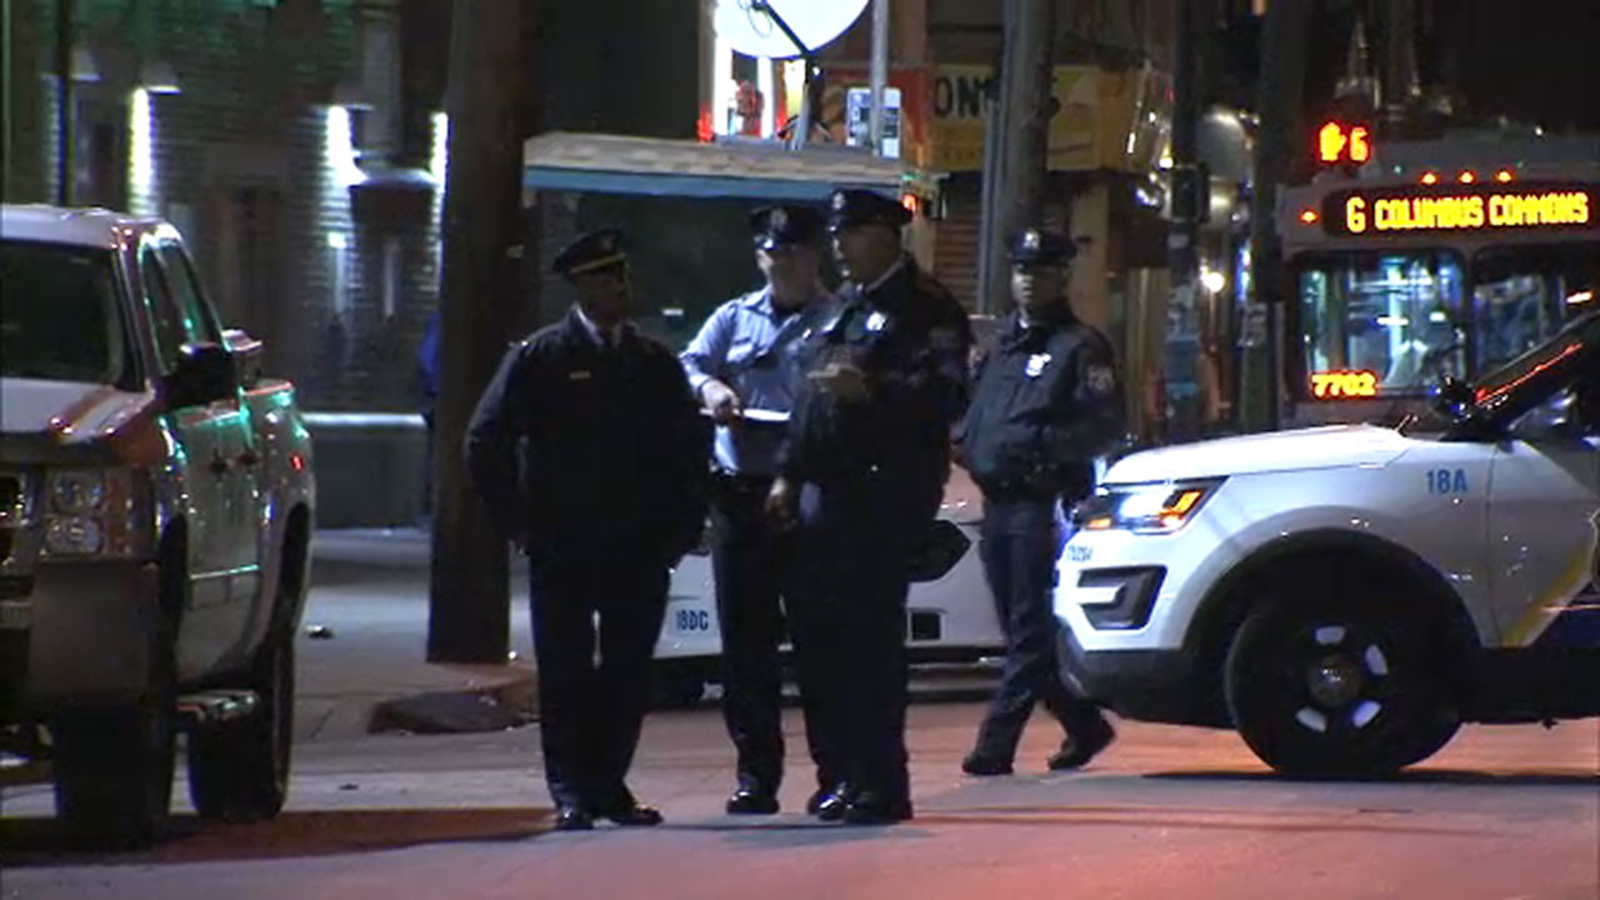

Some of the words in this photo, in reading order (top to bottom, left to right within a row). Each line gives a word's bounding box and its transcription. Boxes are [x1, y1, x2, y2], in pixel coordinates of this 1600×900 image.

[1374, 196, 1483, 230] COLUMBUS
[1489, 193, 1588, 226] COMMONS
[1427, 468, 1468, 494] 18A
